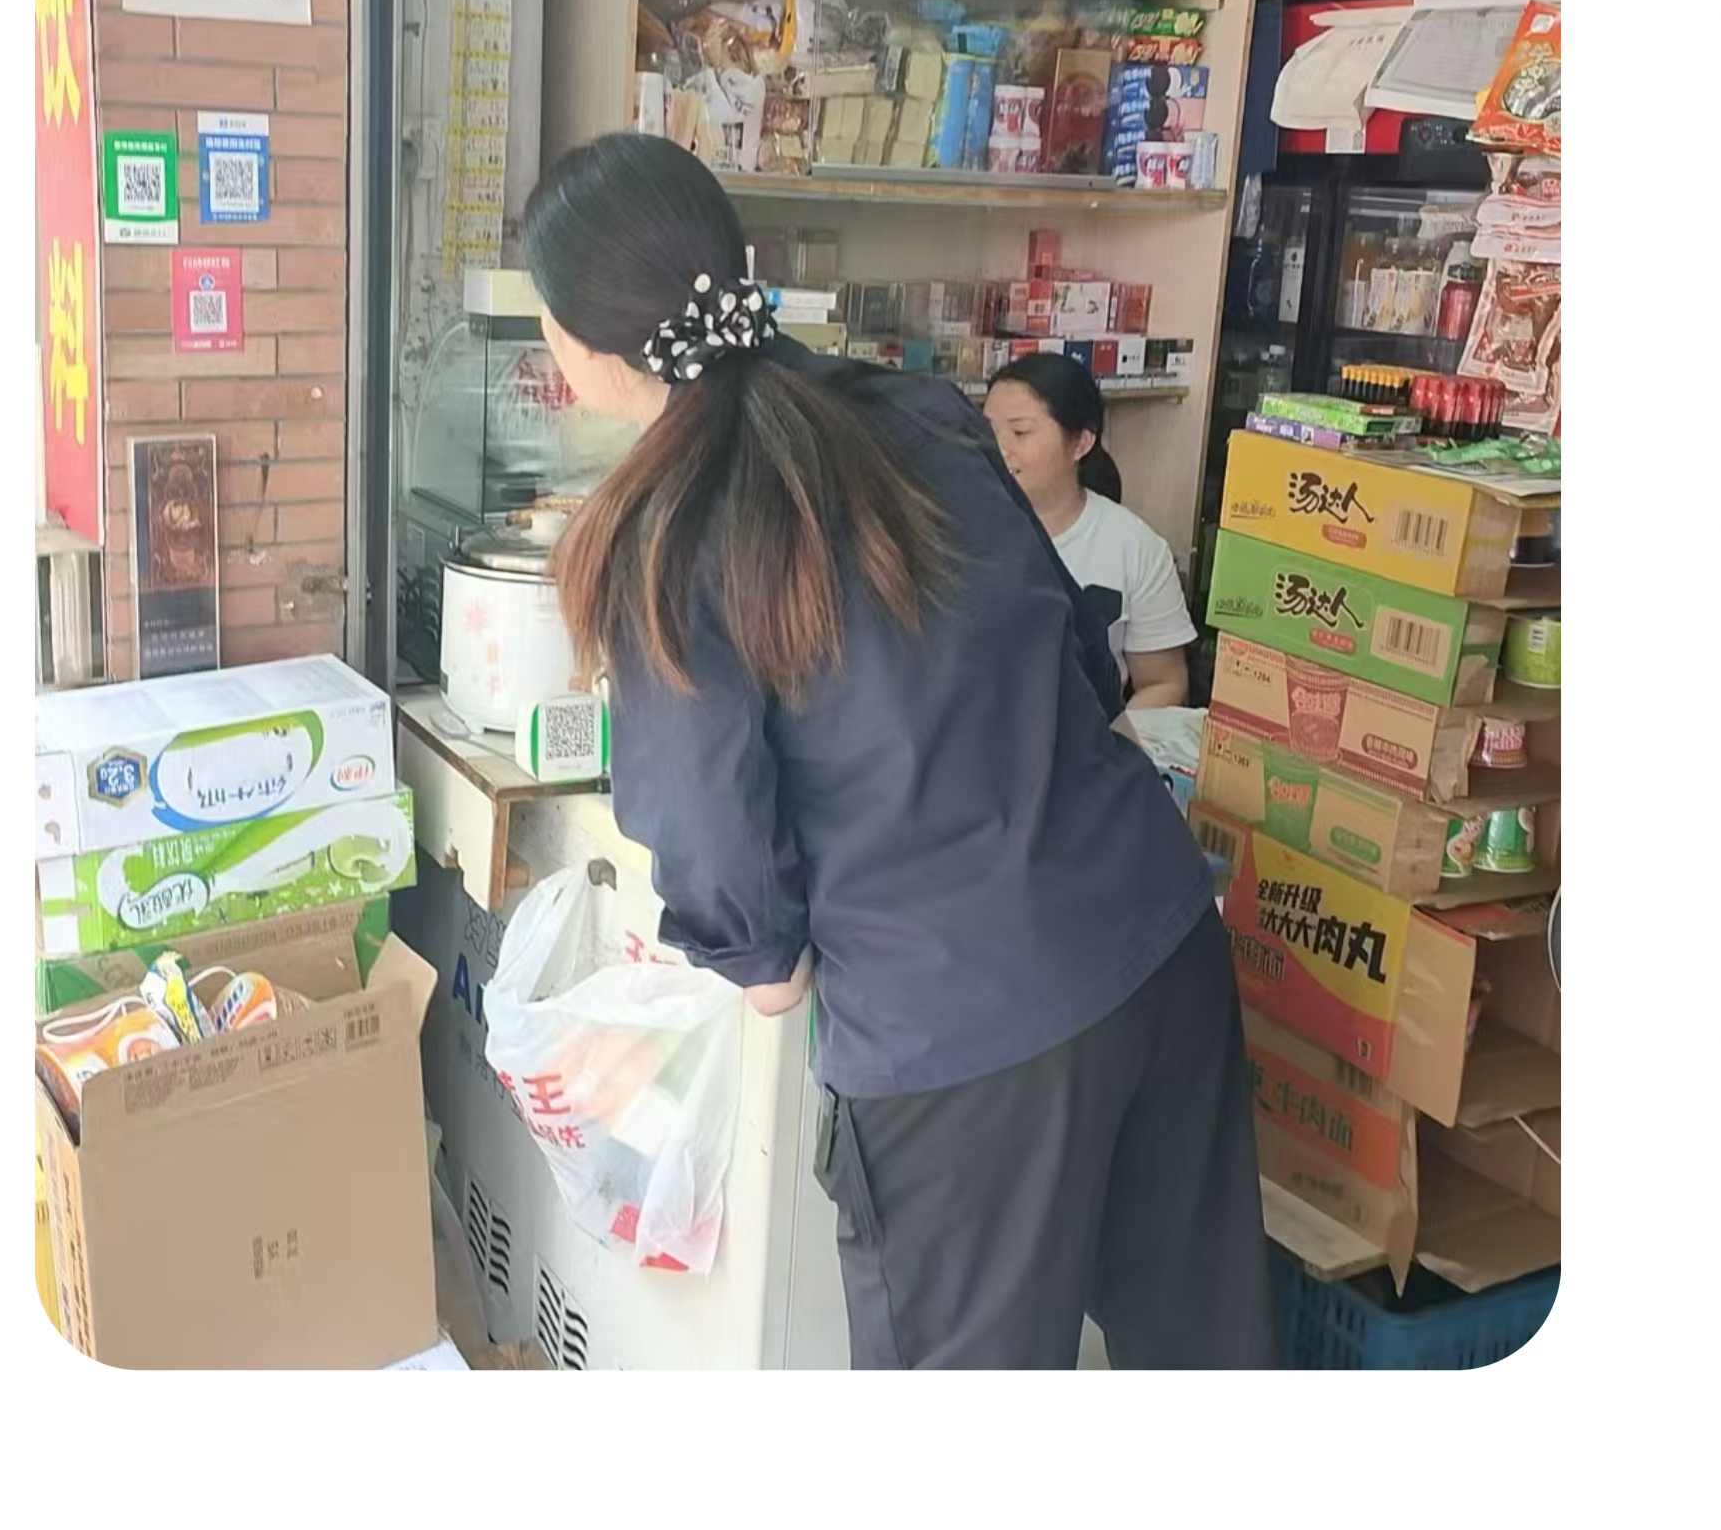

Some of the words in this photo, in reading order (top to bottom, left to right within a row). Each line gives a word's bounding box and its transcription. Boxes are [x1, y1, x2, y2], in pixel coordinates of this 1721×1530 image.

[1287, 472, 1375, 524] 汤达人
[1275, 573, 1365, 629] 汤达人
[1257, 878, 1323, 915] 全新升级
